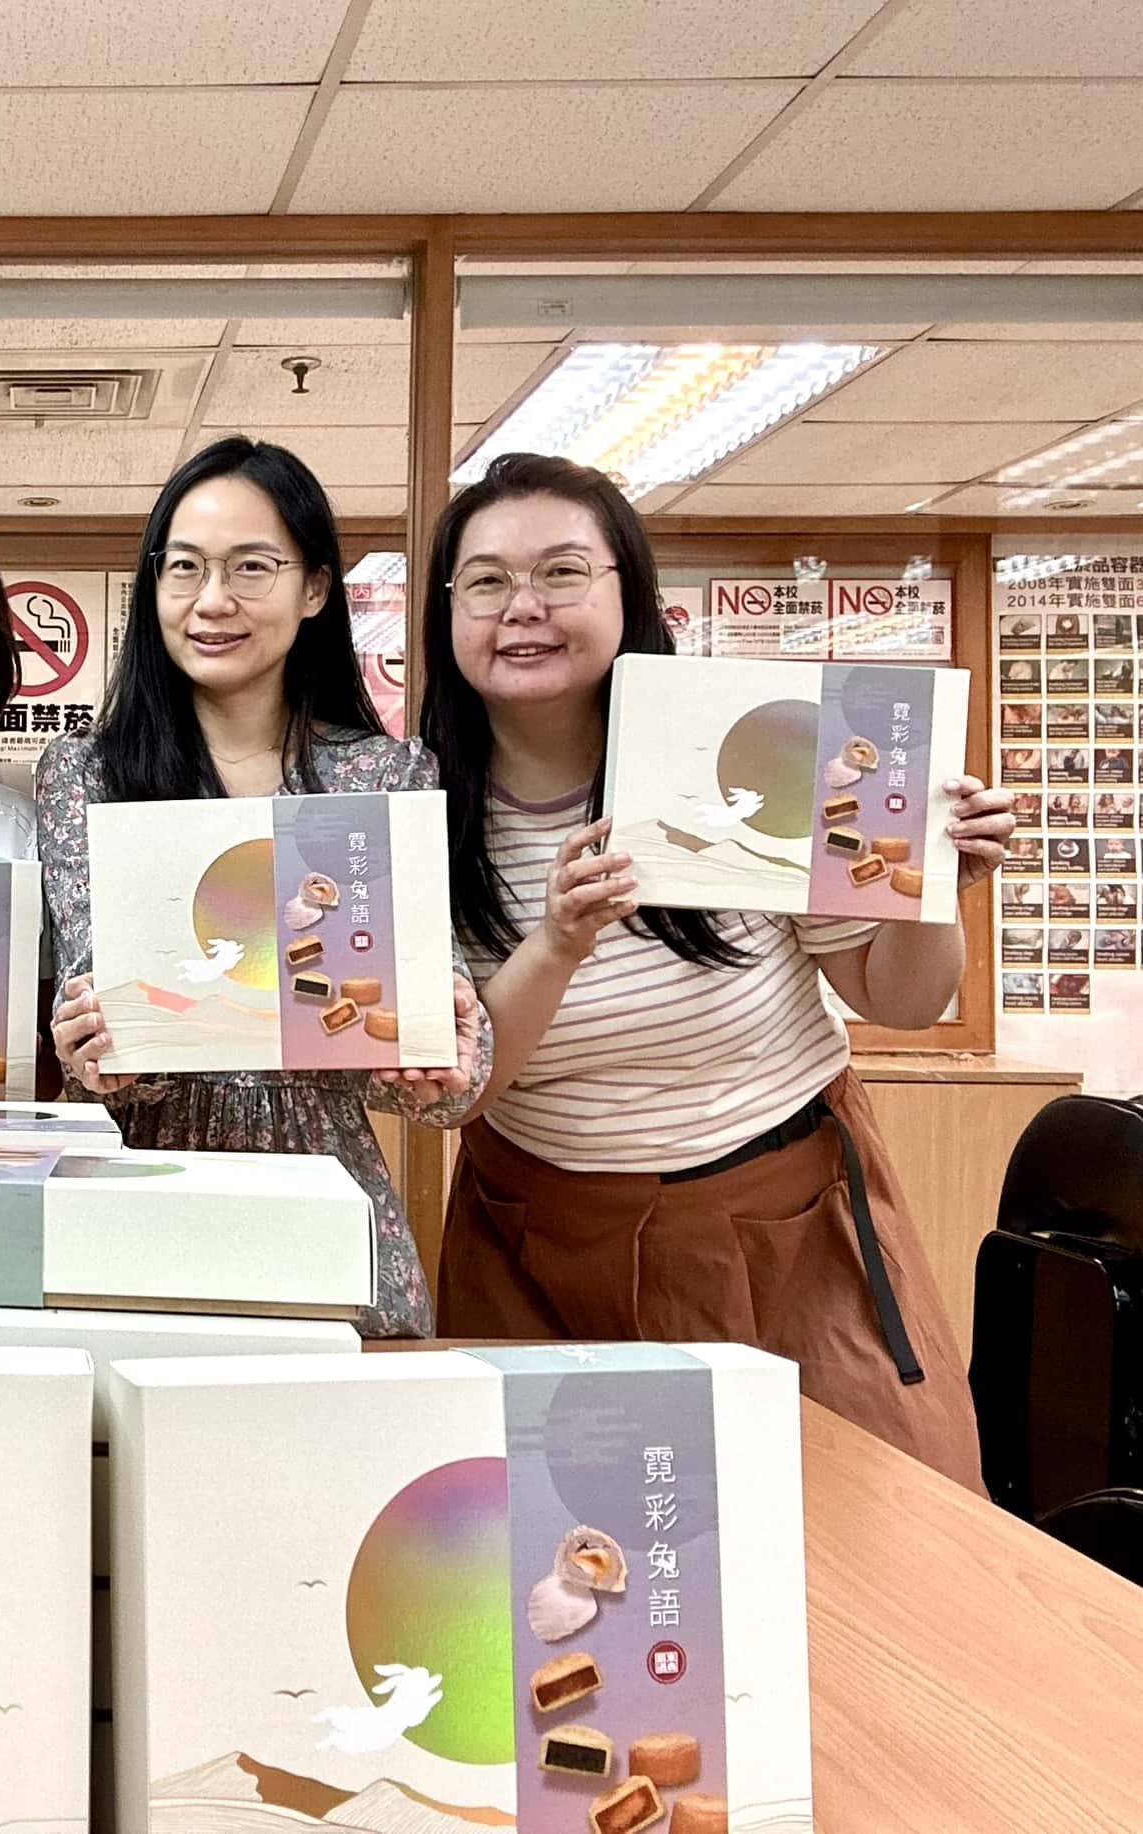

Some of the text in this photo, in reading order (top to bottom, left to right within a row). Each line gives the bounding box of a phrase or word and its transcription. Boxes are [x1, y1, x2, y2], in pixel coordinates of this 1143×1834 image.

[773, 585, 798, 599] 本校
[773, 601, 824, 615] 全面禁菸
[895, 585, 920, 599] 本校
[888, 702, 911, 788] 霓彩兔語
[348, 832, 369, 924] 霓彩兔語
[642, 1446, 682, 1627] 霓彩兔語
